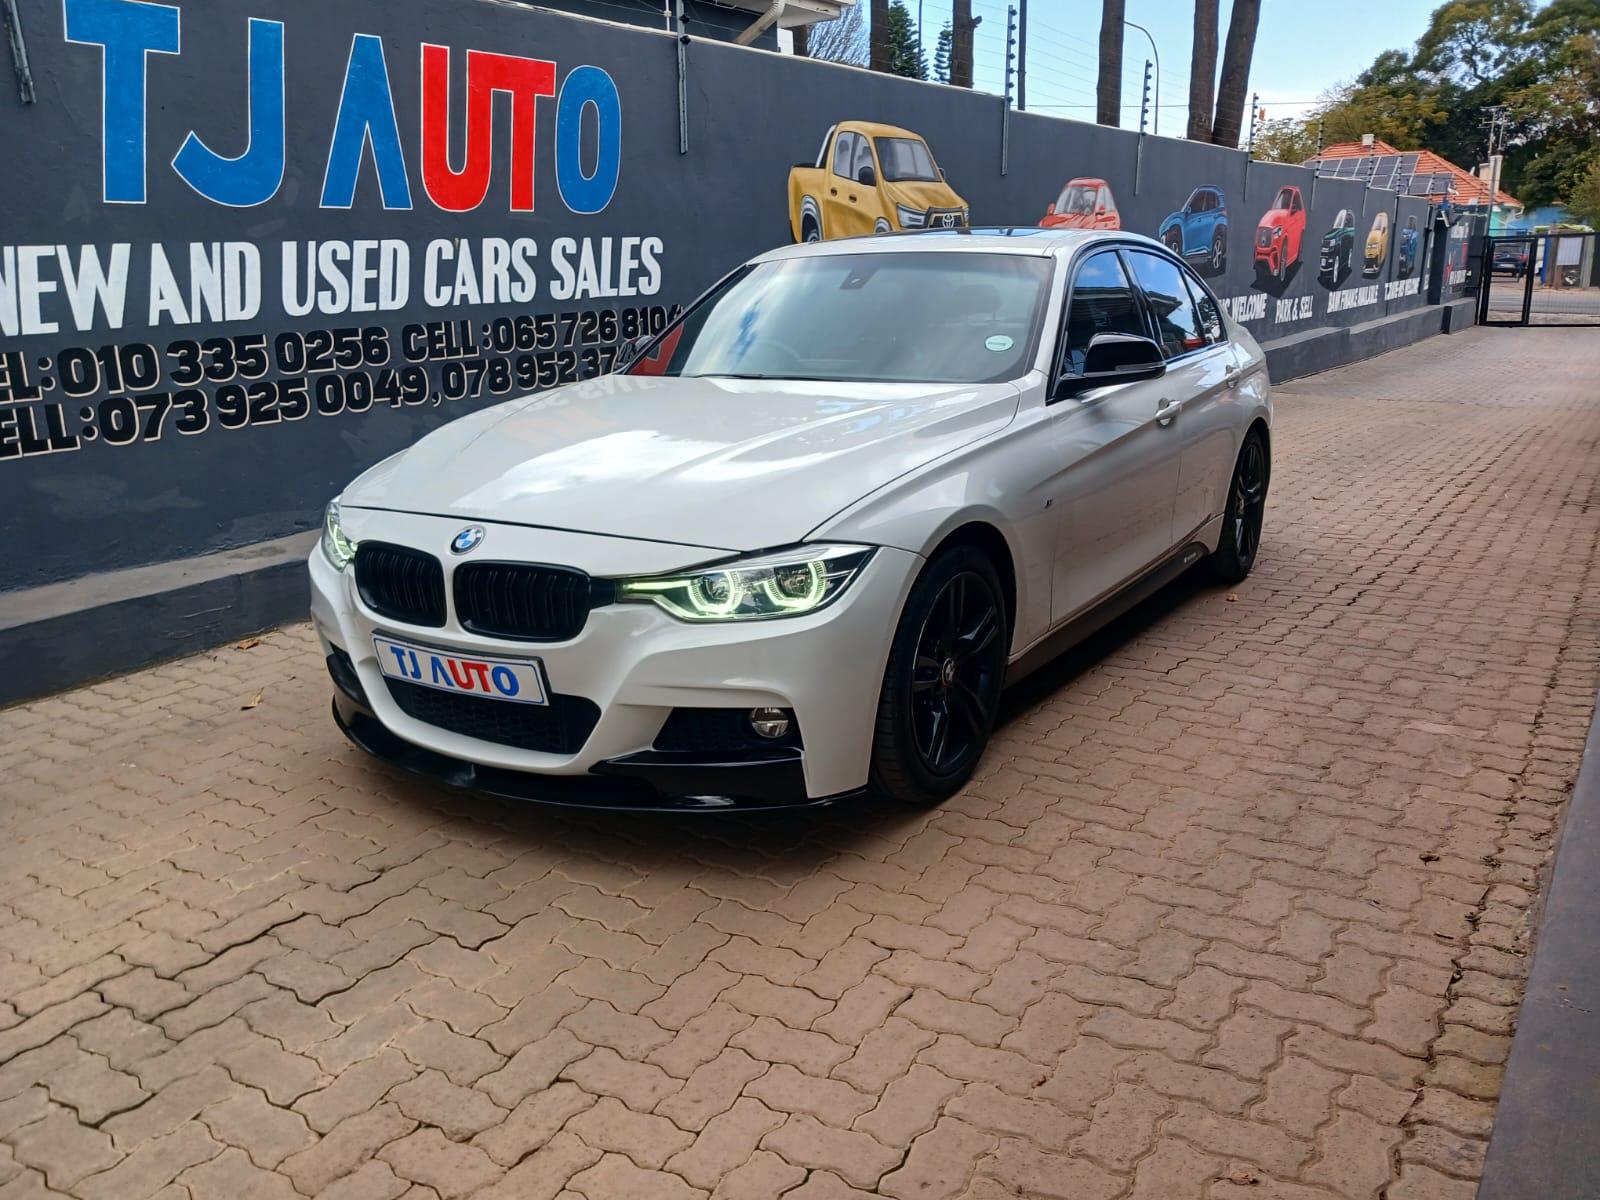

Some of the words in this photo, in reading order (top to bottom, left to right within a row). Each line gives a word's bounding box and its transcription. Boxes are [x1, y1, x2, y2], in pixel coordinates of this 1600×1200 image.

[319, 33, 621, 214] AUTO
[149, 241, 261, 327] AND
[281, 238, 410, 317] USED
[423, 237, 538, 307] CARS
[549, 236, 664, 297] SALES
[166, 334, 269, 387] 335
[275, 327, 391, 375] 0256
[560, 310, 619, 347] 726
[215, 378, 310, 430] 925
[390, 646, 422, 680] TJ
[430, 655, 520, 697] AUTO
